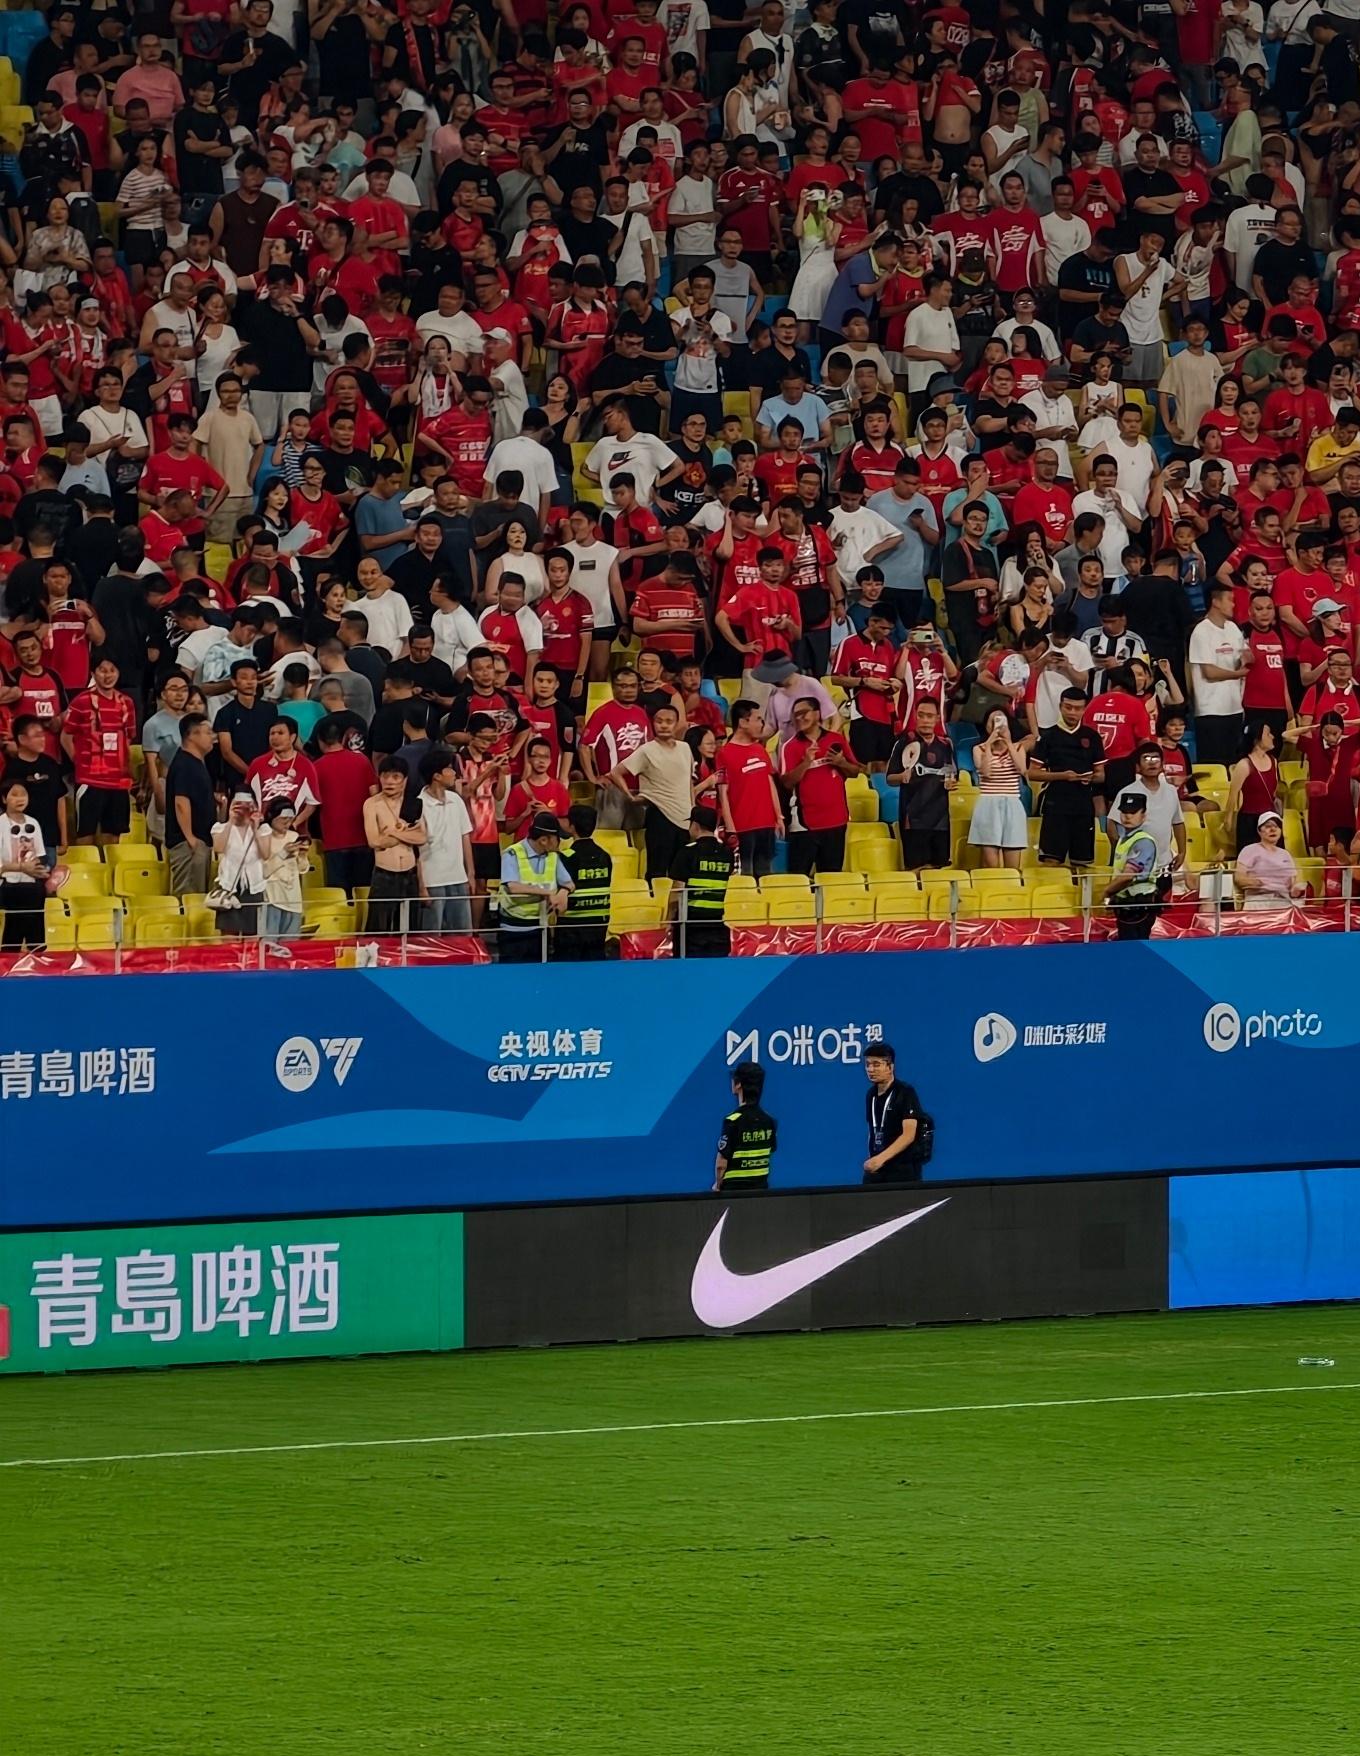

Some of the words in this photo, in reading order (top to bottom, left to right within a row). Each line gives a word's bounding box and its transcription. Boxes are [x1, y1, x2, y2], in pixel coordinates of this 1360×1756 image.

[1023, 1022, 1107, 1047] 咪咕彩媒
[1245, 1008, 1322, 1047] photo
[499, 1028, 603, 1059] 央视体育
[284, 1049, 312, 1066] EA
[487, 1065, 529, 1083] CCTV
[530, 1061, 611, 1081] SPORTS
